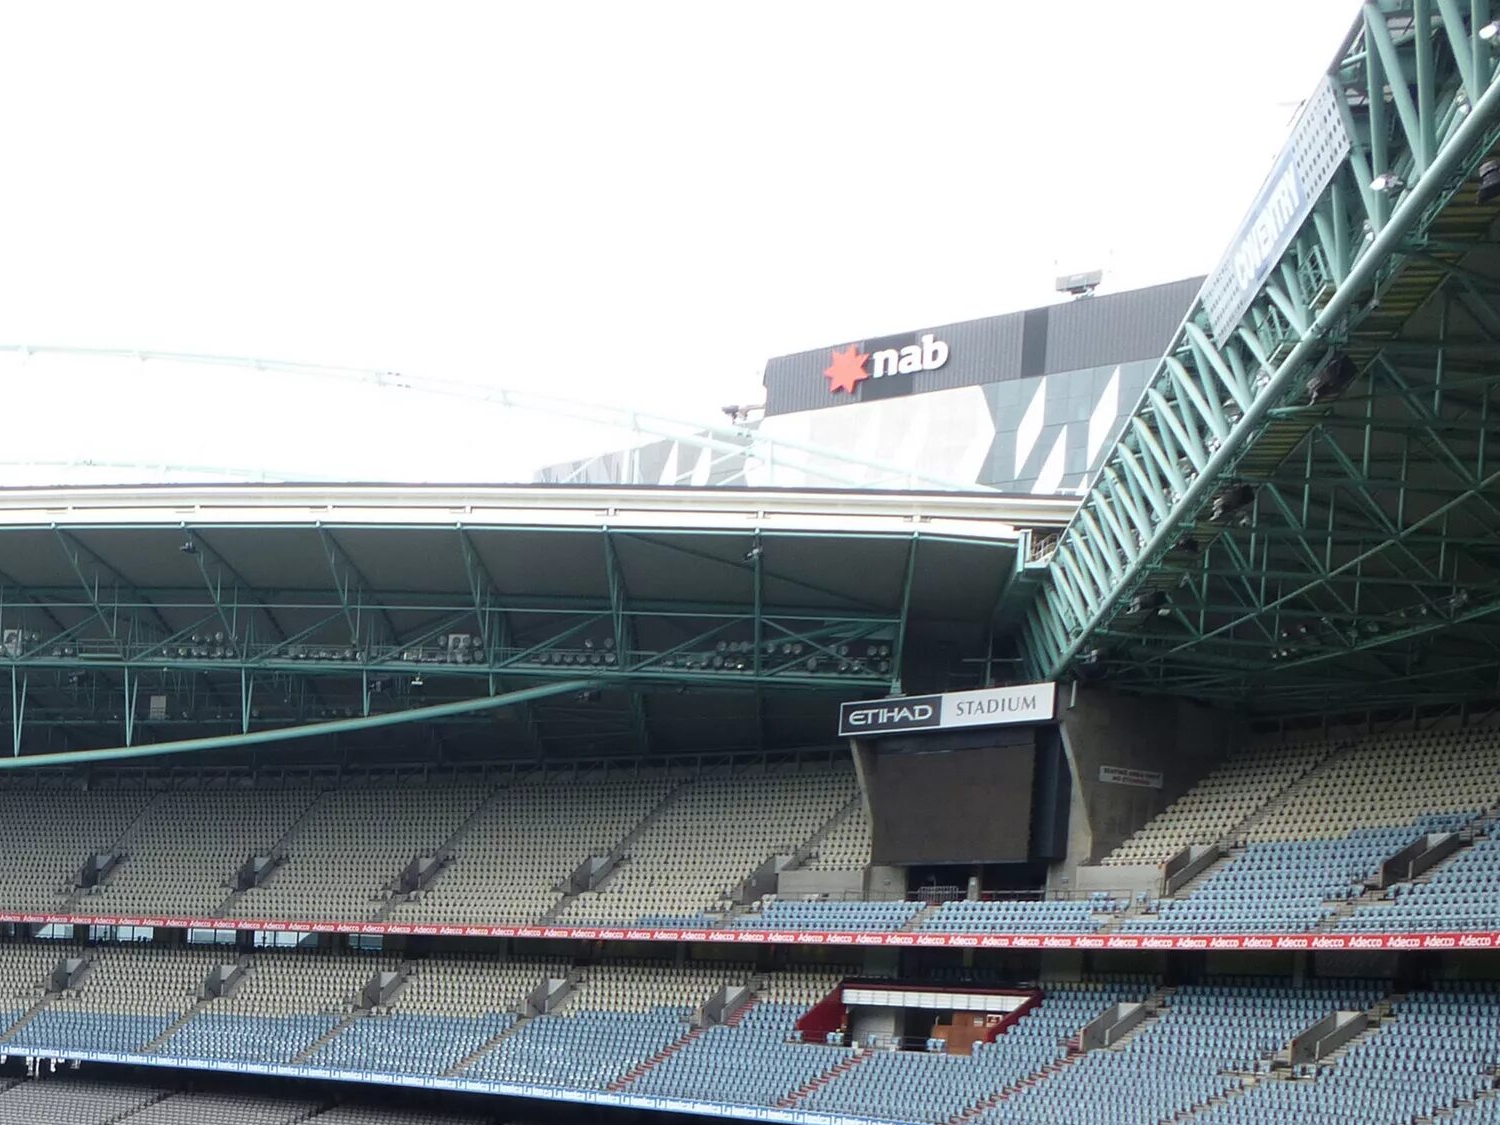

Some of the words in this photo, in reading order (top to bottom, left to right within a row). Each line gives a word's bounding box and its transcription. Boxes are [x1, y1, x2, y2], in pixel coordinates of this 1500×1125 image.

[872, 334, 949, 378] nab
[849, 704, 933, 725] ETIHAD
[955, 695, 1037, 717] STADIUM
